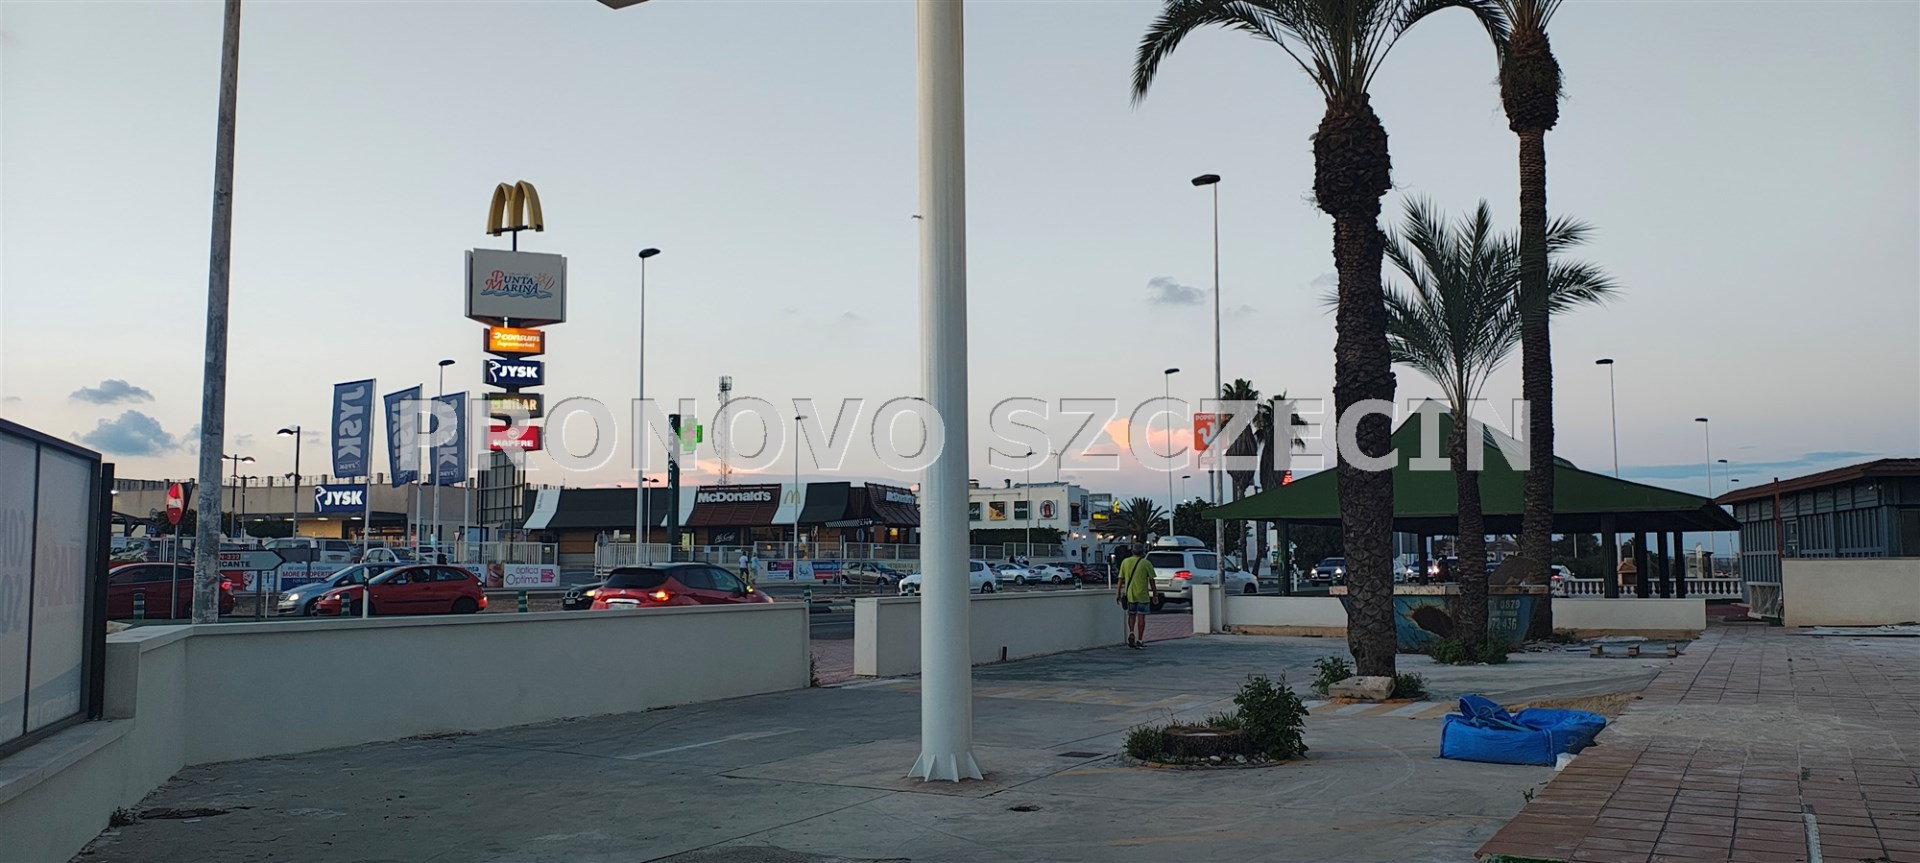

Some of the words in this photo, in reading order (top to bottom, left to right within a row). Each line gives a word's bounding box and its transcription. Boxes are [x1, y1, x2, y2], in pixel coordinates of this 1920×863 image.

[491, 269, 534, 285] PUNTA
[482, 278, 540, 295] MARINA
[501, 333, 540, 342] consum
[499, 365, 538, 378] JYSK
[502, 398, 537, 411] MILAR
[492, 439, 534, 447] MAPFRE
[324, 490, 363, 505] JYSK
[698, 491, 771, 503] McDonald's
